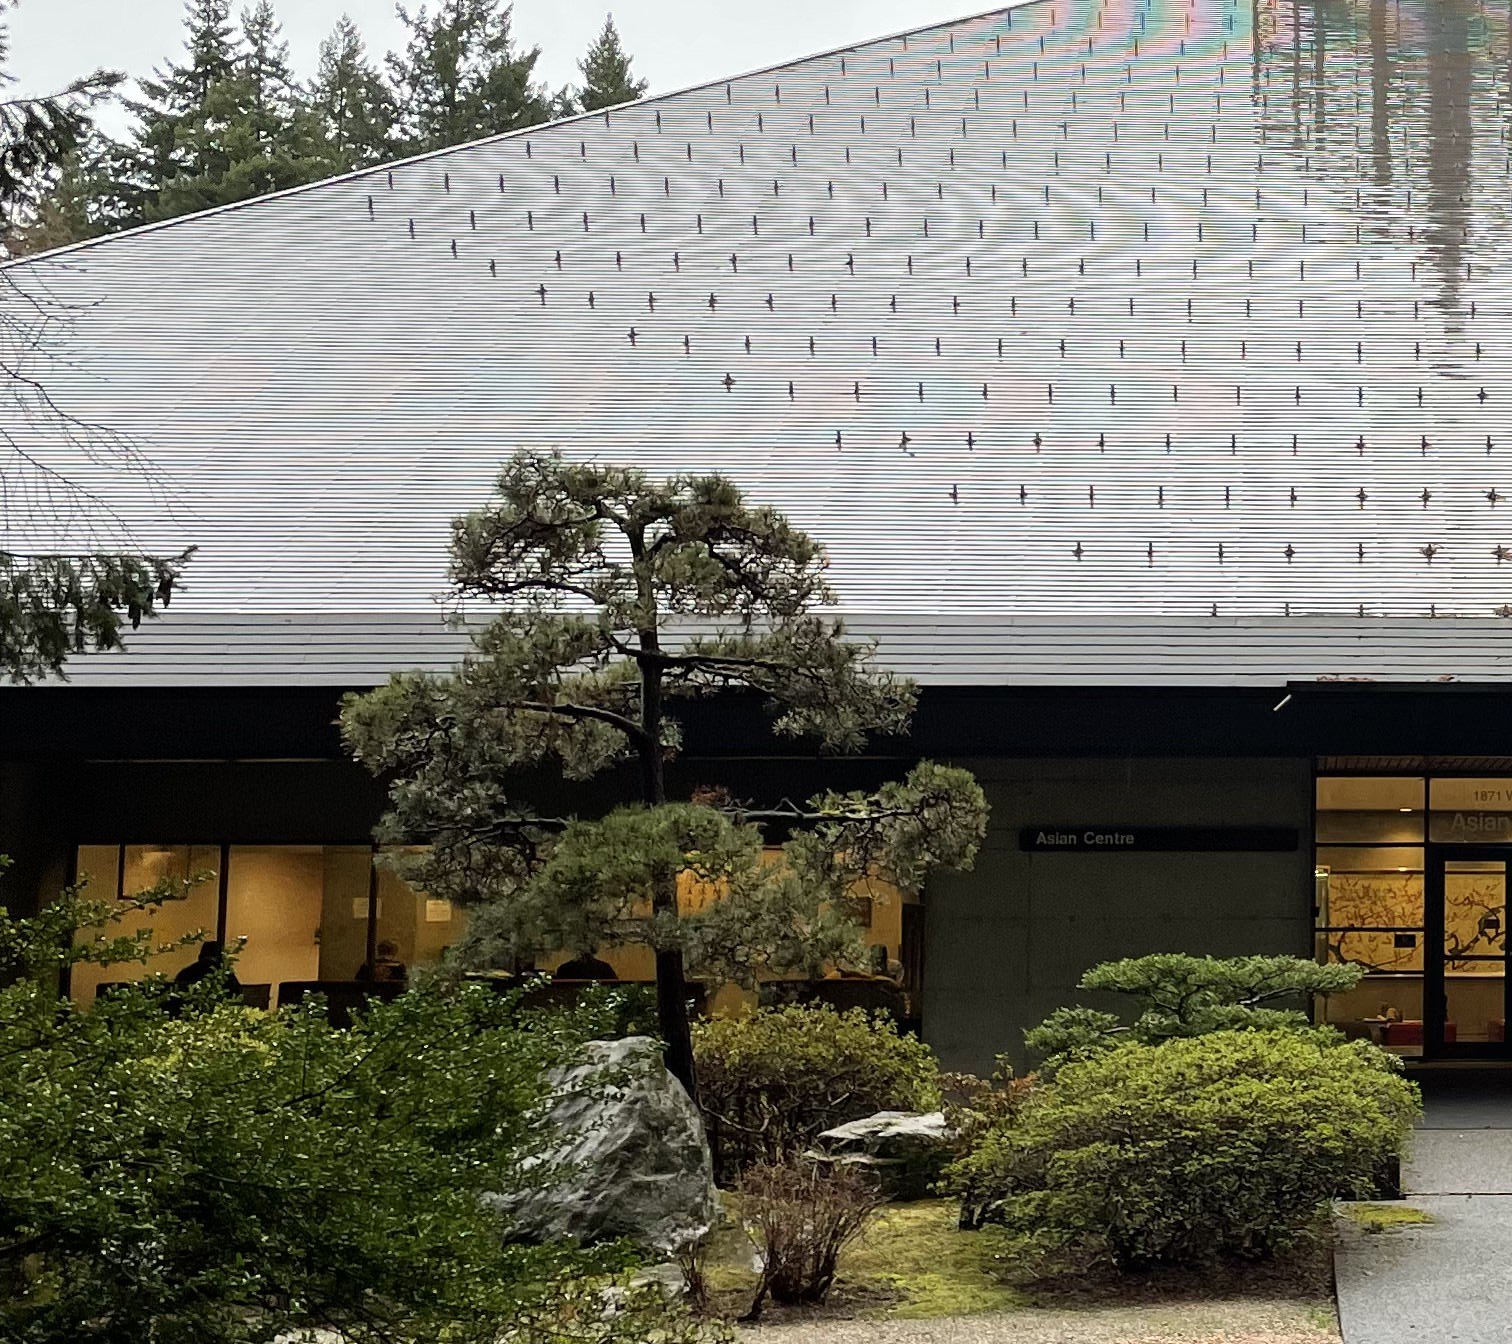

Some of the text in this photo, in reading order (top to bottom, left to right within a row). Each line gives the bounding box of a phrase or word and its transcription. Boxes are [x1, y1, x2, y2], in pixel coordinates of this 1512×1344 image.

[1473, 790, 1501, 802] 1871
[1451, 812, 1510, 832] Asian
[1036, 831, 1135, 845] Asian Centre
